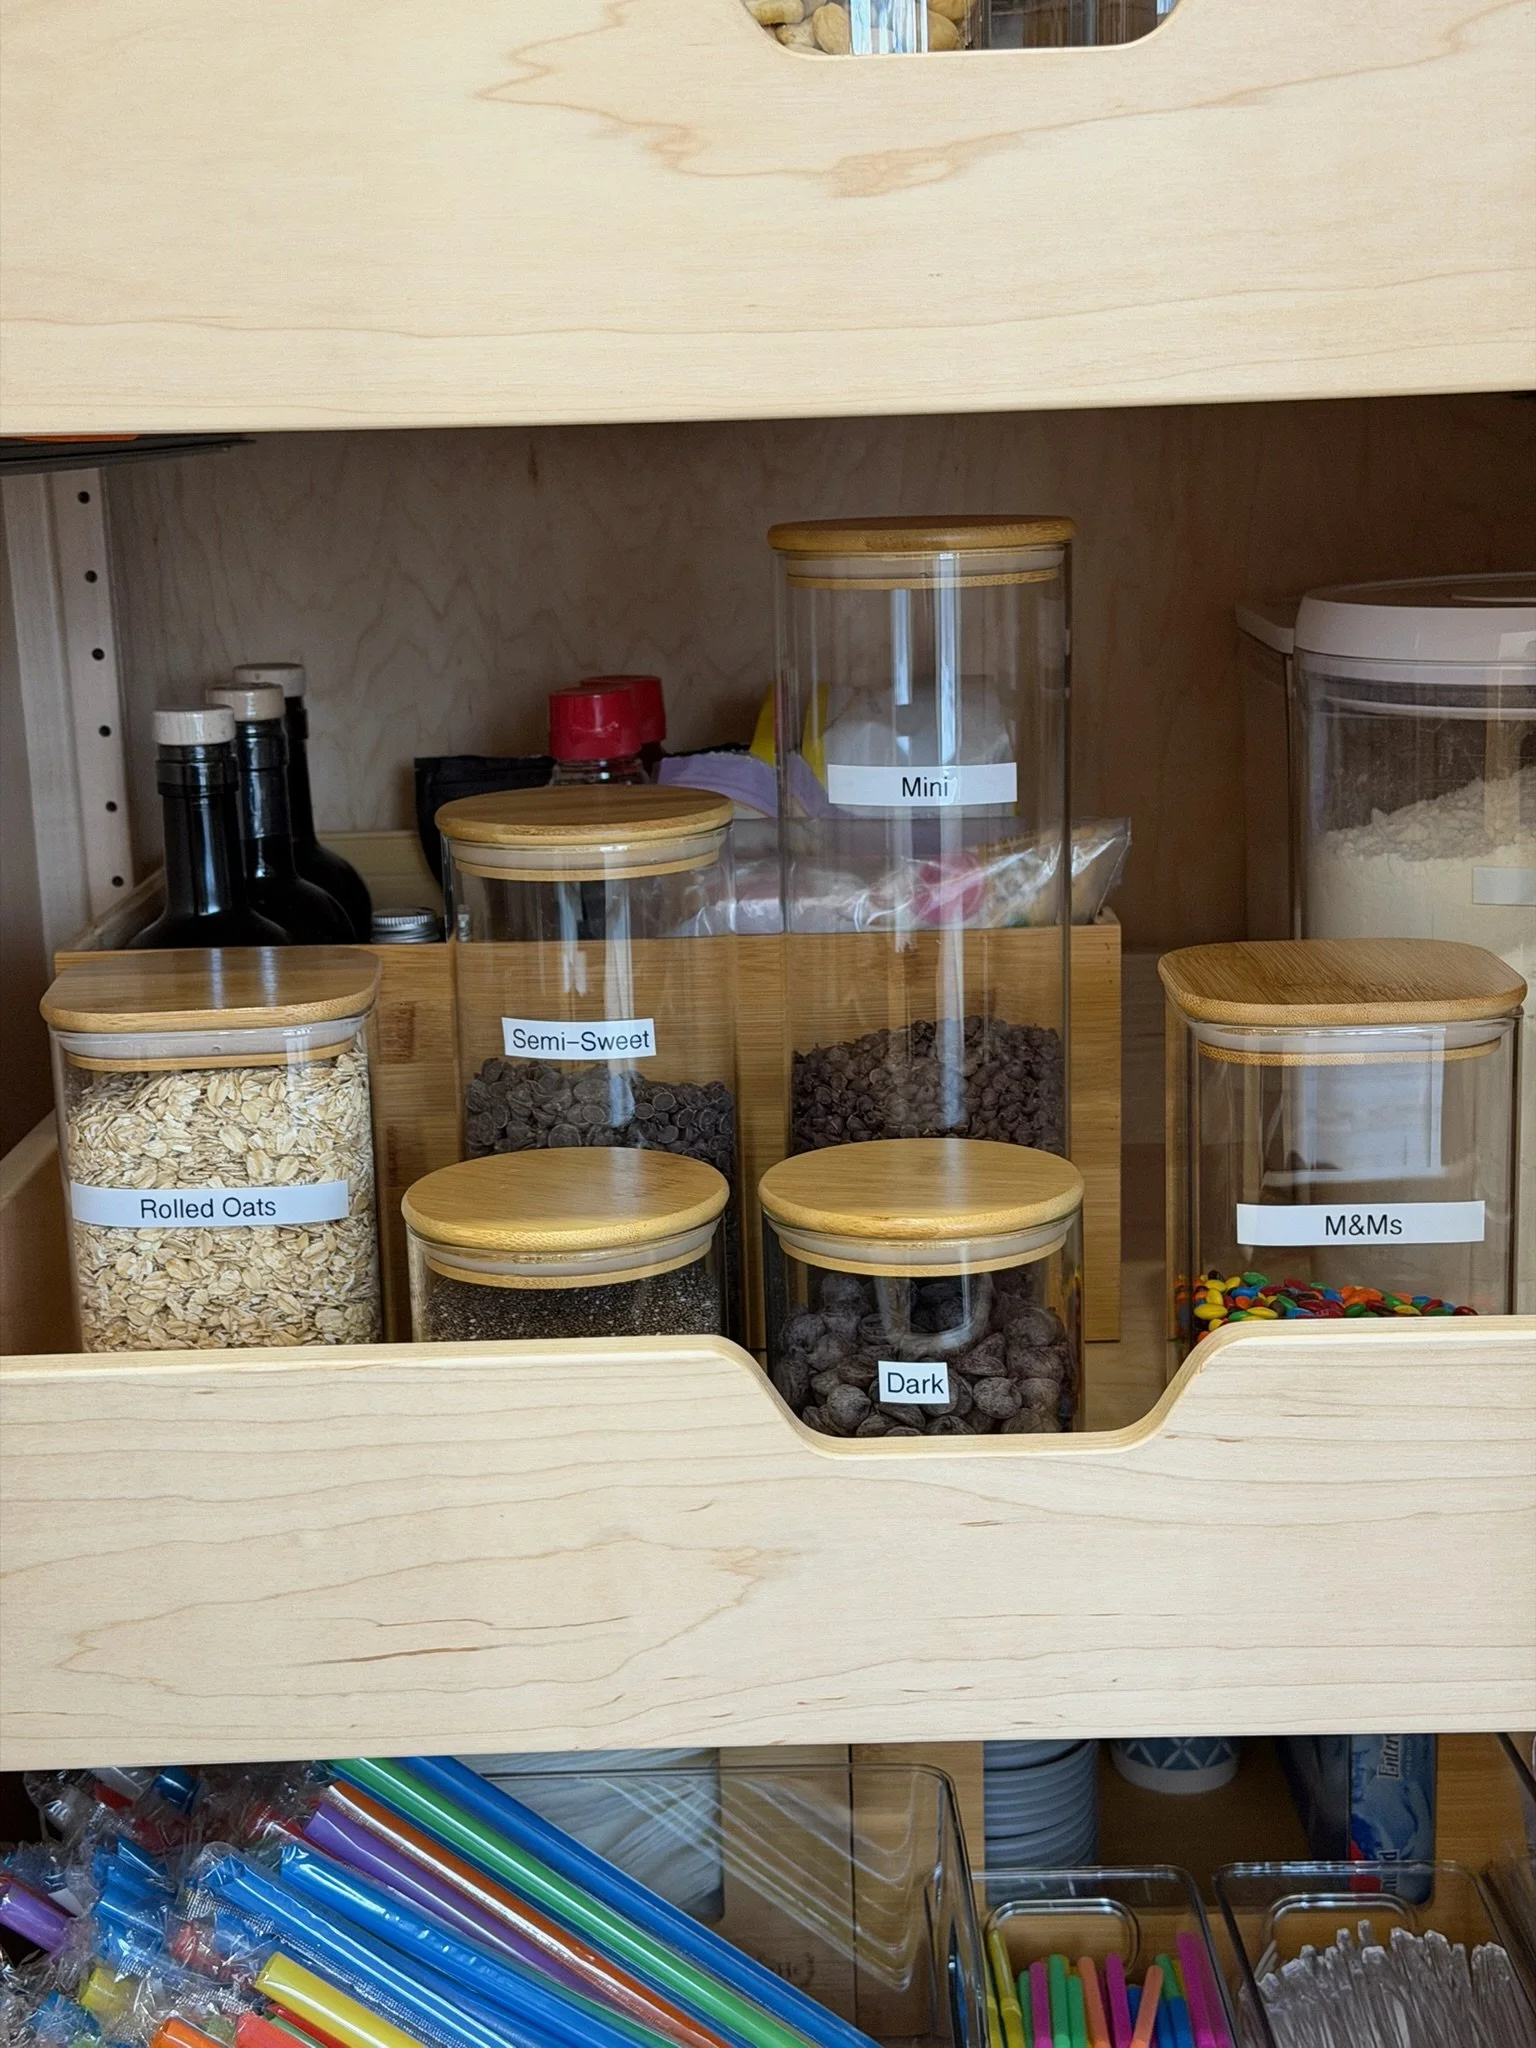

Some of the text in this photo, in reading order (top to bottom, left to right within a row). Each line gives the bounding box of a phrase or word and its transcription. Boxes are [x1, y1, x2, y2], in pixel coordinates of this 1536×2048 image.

[902, 776, 948, 797] Mini
[512, 1028, 650, 1051] Semi-Sweet
[140, 1197, 277, 1219] Rolled Oats
[1325, 1214, 1403, 1236] M&Ms
[887, 1371, 945, 1395] Dark
